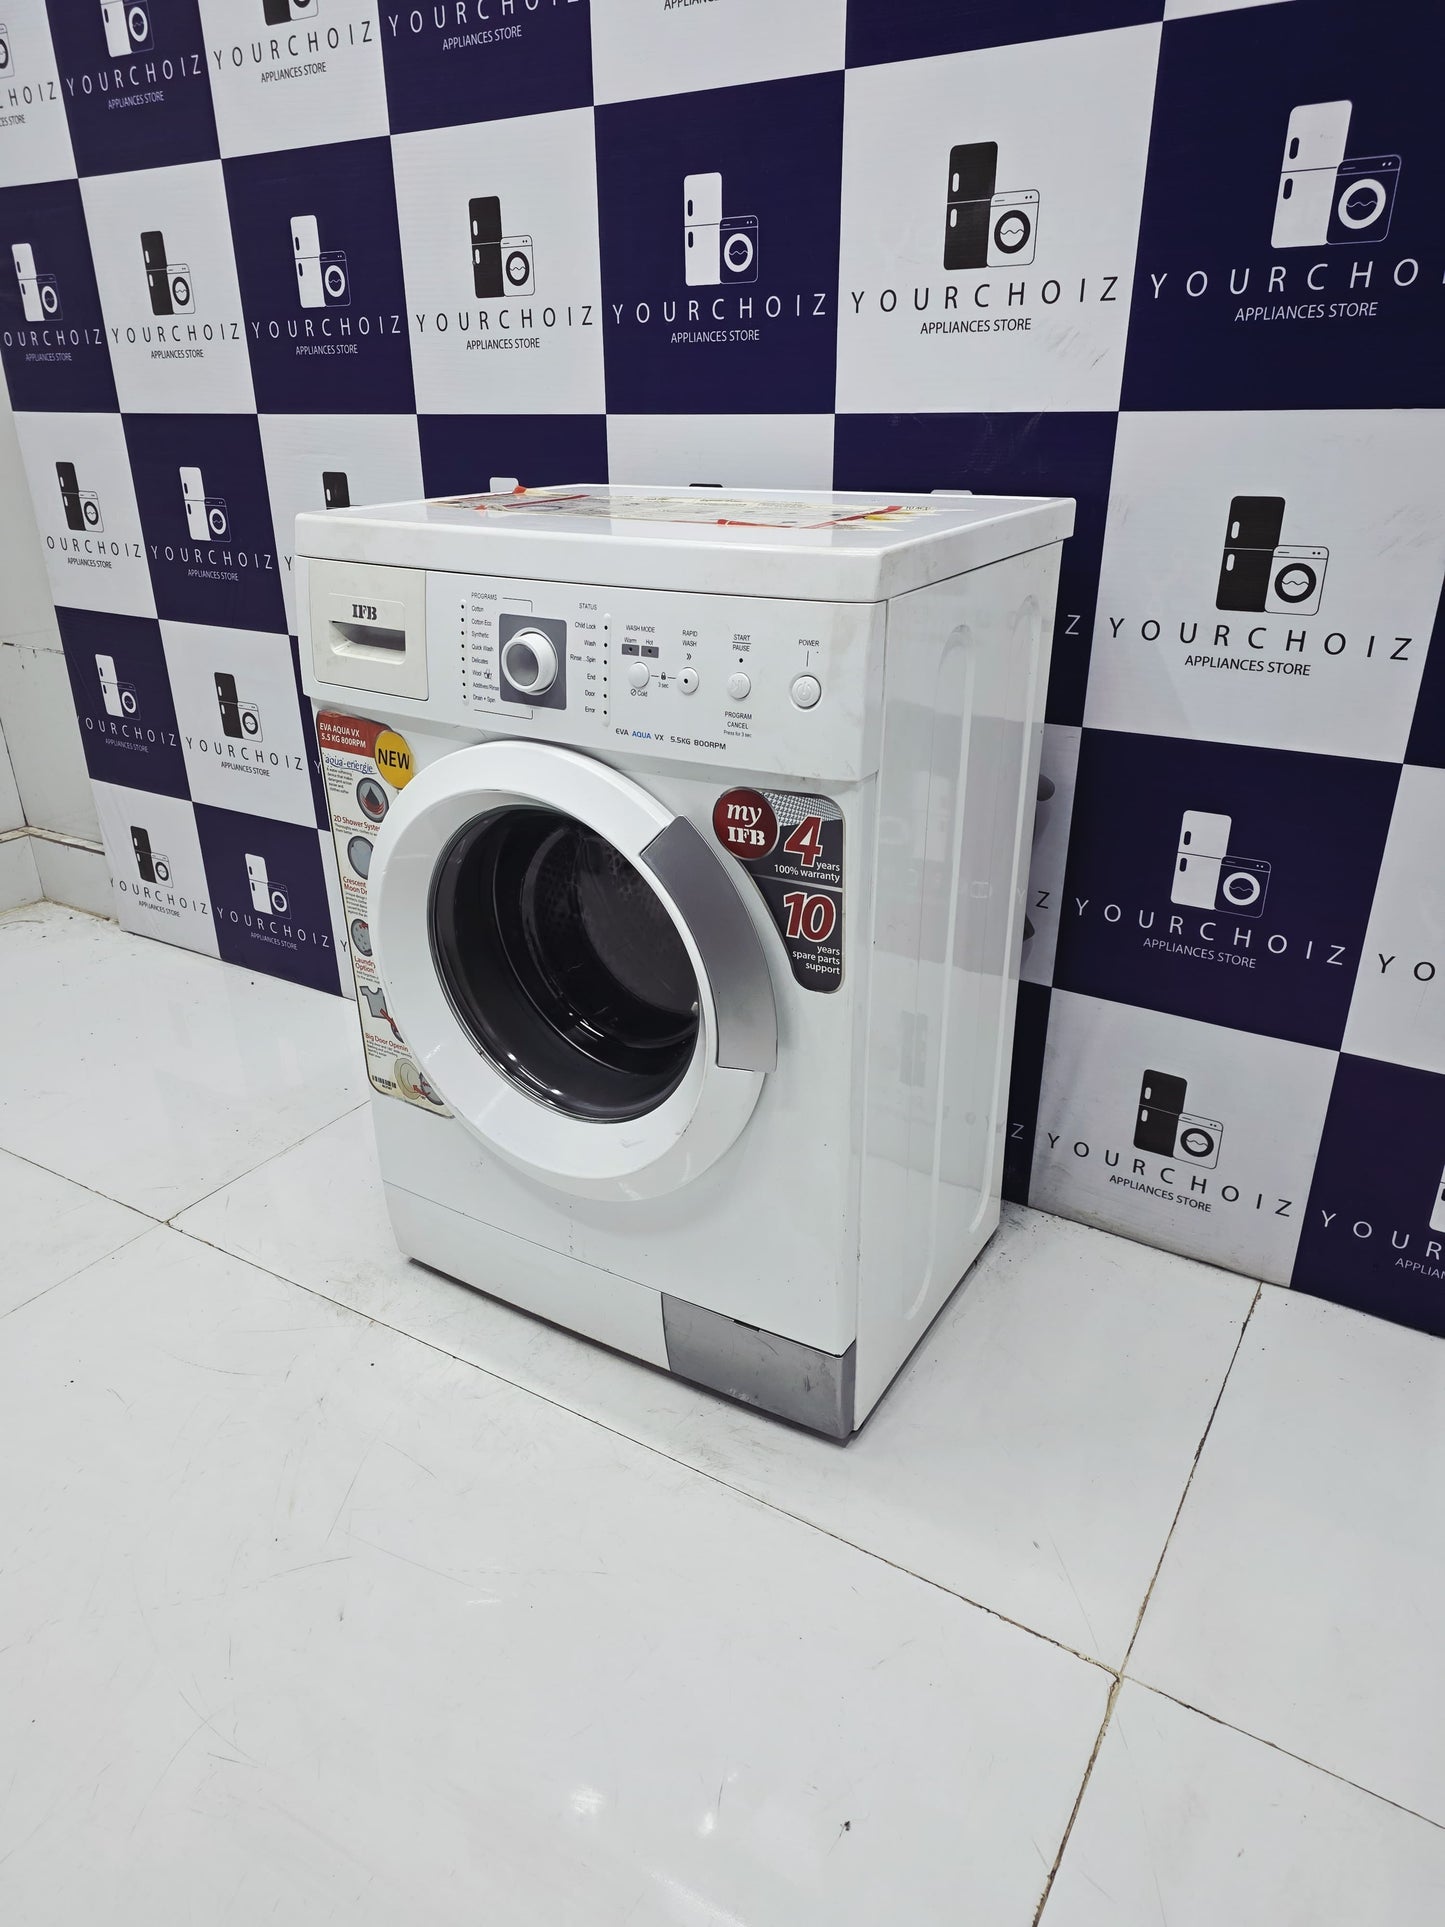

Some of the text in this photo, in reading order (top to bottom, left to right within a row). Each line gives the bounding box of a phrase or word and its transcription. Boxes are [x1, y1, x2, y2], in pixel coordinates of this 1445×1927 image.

[213, 20, 373, 70] YOURCHOIZ
[443, 25, 522, 51] APPLIANCES STORE
[66, 54, 201, 97] YOURCHOIZ
[261, 61, 327, 83] APPLIANCES STORE
[108, 90, 164, 110] APPLIANCES STORE
[851, 276, 1118, 314] YOURCHOIZ
[612, 293, 826, 324] YOURCHOIZ
[1235, 301, 1378, 321] APPLIANCES STORE
[252, 315, 400, 339] YOURCHOIZ
[416, 305, 593, 333] YOURCHOIZ
[920, 317, 1031, 334] APPLIANCES STORE
[112, 323, 240, 344] YOURCHOIZ
[466, 337, 540, 350] APPLIANCES STORE
[671, 329, 760, 344] APPLIANCES STORE
[25, 352, 72, 361] APPLIANCES STORE
[151, 348, 204, 361] APPLIANCES STORE
[296, 343, 358, 356] APPLIANCES STORE
[67, 557, 112, 569] APPLIANCES STORE
[151, 545, 272, 570] YOURCHOIZ
[188, 569, 239, 581] APPLIANCES STORE
[471, 592, 497, 601] PROGRAMS
[352, 604, 377, 620] IFB
[579, 603, 597, 611] STATUS
[472, 631, 489, 639] Synthetic
[1109, 617, 1413, 661] YOURCHOIZ
[733, 644, 750, 652] PAUSE
[1185, 655, 1312, 676] APPLIANCES STORE
[725, 711, 752, 720] PROGRAM
[727, 721, 749, 730] CANCEL
[78, 715, 177, 747] OURCHOIZ
[320, 722, 360, 738] EVA AQUA VX
[616, 728, 727, 750] EVA AQUA VX 5.5KG 800RPM
[321, 733, 366, 749] 5.5 KG 800RPM
[185, 736, 303, 771] YOURCHOIZ
[378, 748, 410, 770] NEW
[221, 761, 270, 777] APPLIANCES STORE
[342, 817, 364, 828] Shower
[364, 821, 381, 833] Syste
[727, 803, 762, 828] my
[727, 826, 766, 846] IFB
[783, 815, 823, 868] 4
[774, 863, 841, 884] 100% warranty
[816, 861, 841, 872] years
[342, 876, 367, 887] Crescent
[343, 883, 361, 894] Moon
[217, 906, 330, 948] YOURCHOIZ
[783, 891, 837, 943] 10
[250, 931, 298, 951] APPLIANCES STORE
[1075, 897, 1346, 966] YOURCHOIZ
[792, 950, 841, 966] spare parts
[816, 945, 841, 956] years
[1143, 937, 1257, 968] APPLIANCES STORE
[805, 962, 841, 975] support
[365, 1032, 375, 1043] Big
[374, 1034, 389, 1046] Door
[389, 1039, 409, 1053] Openin
[1046, 1132, 1293, 1217] YOURCHOIZ
[1110, 1174, 1212, 1212] APPLIANCES STORE
